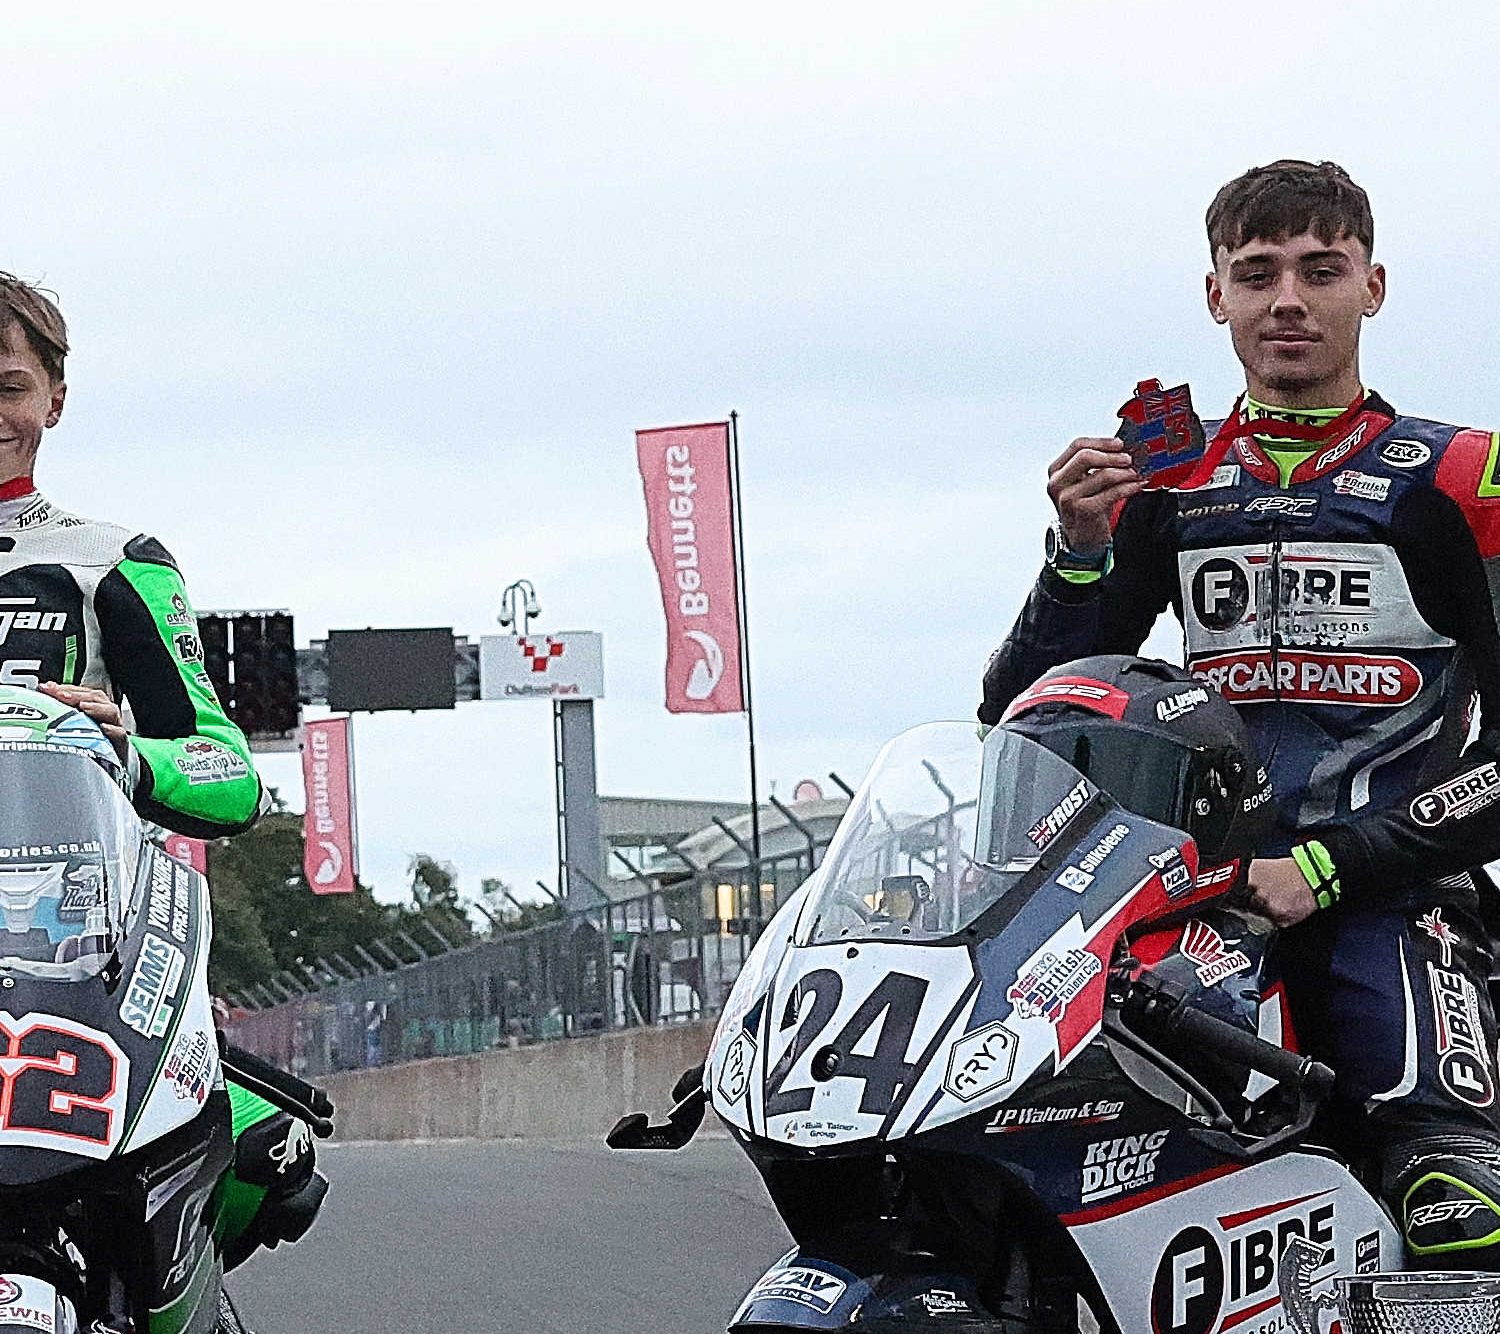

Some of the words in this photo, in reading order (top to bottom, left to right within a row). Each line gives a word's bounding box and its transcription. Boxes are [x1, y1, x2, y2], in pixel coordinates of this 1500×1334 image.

[1315, 422, 1368, 471] RST
[1382, 443, 1422, 461] R&G
[1244, 496, 1320, 512] RST
[1350, 476, 1388, 493] British
[1229, 661, 1297, 692] CAR
[1301, 663, 1402, 696] PARTS
[1047, 778, 1092, 837] FROST
[1417, 767, 1500, 820] FIBRE
[1080, 822, 1131, 873] silkolene
[147, 849, 173, 933] YORKSHIRE
[125, 936, 172, 1032] SEMMS
[1035, 948, 1087, 999] British
[1201, 950, 1250, 984] HONDA
[765, 968, 930, 1118] 24
[1437, 970, 1485, 1094] FIBRE
[181, 1030, 209, 1080] British
[1018, 1103, 1077, 1125] Walton
[1078, 1101, 1092, 1119] &
[1093, 1098, 1124, 1116] Son
[1085, 1128, 1169, 1164] KING
[1081, 1153, 1160, 1195] DICK
[1123, 1173, 1155, 1191] TOOLS
[1407, 1200, 1489, 1235] RST
